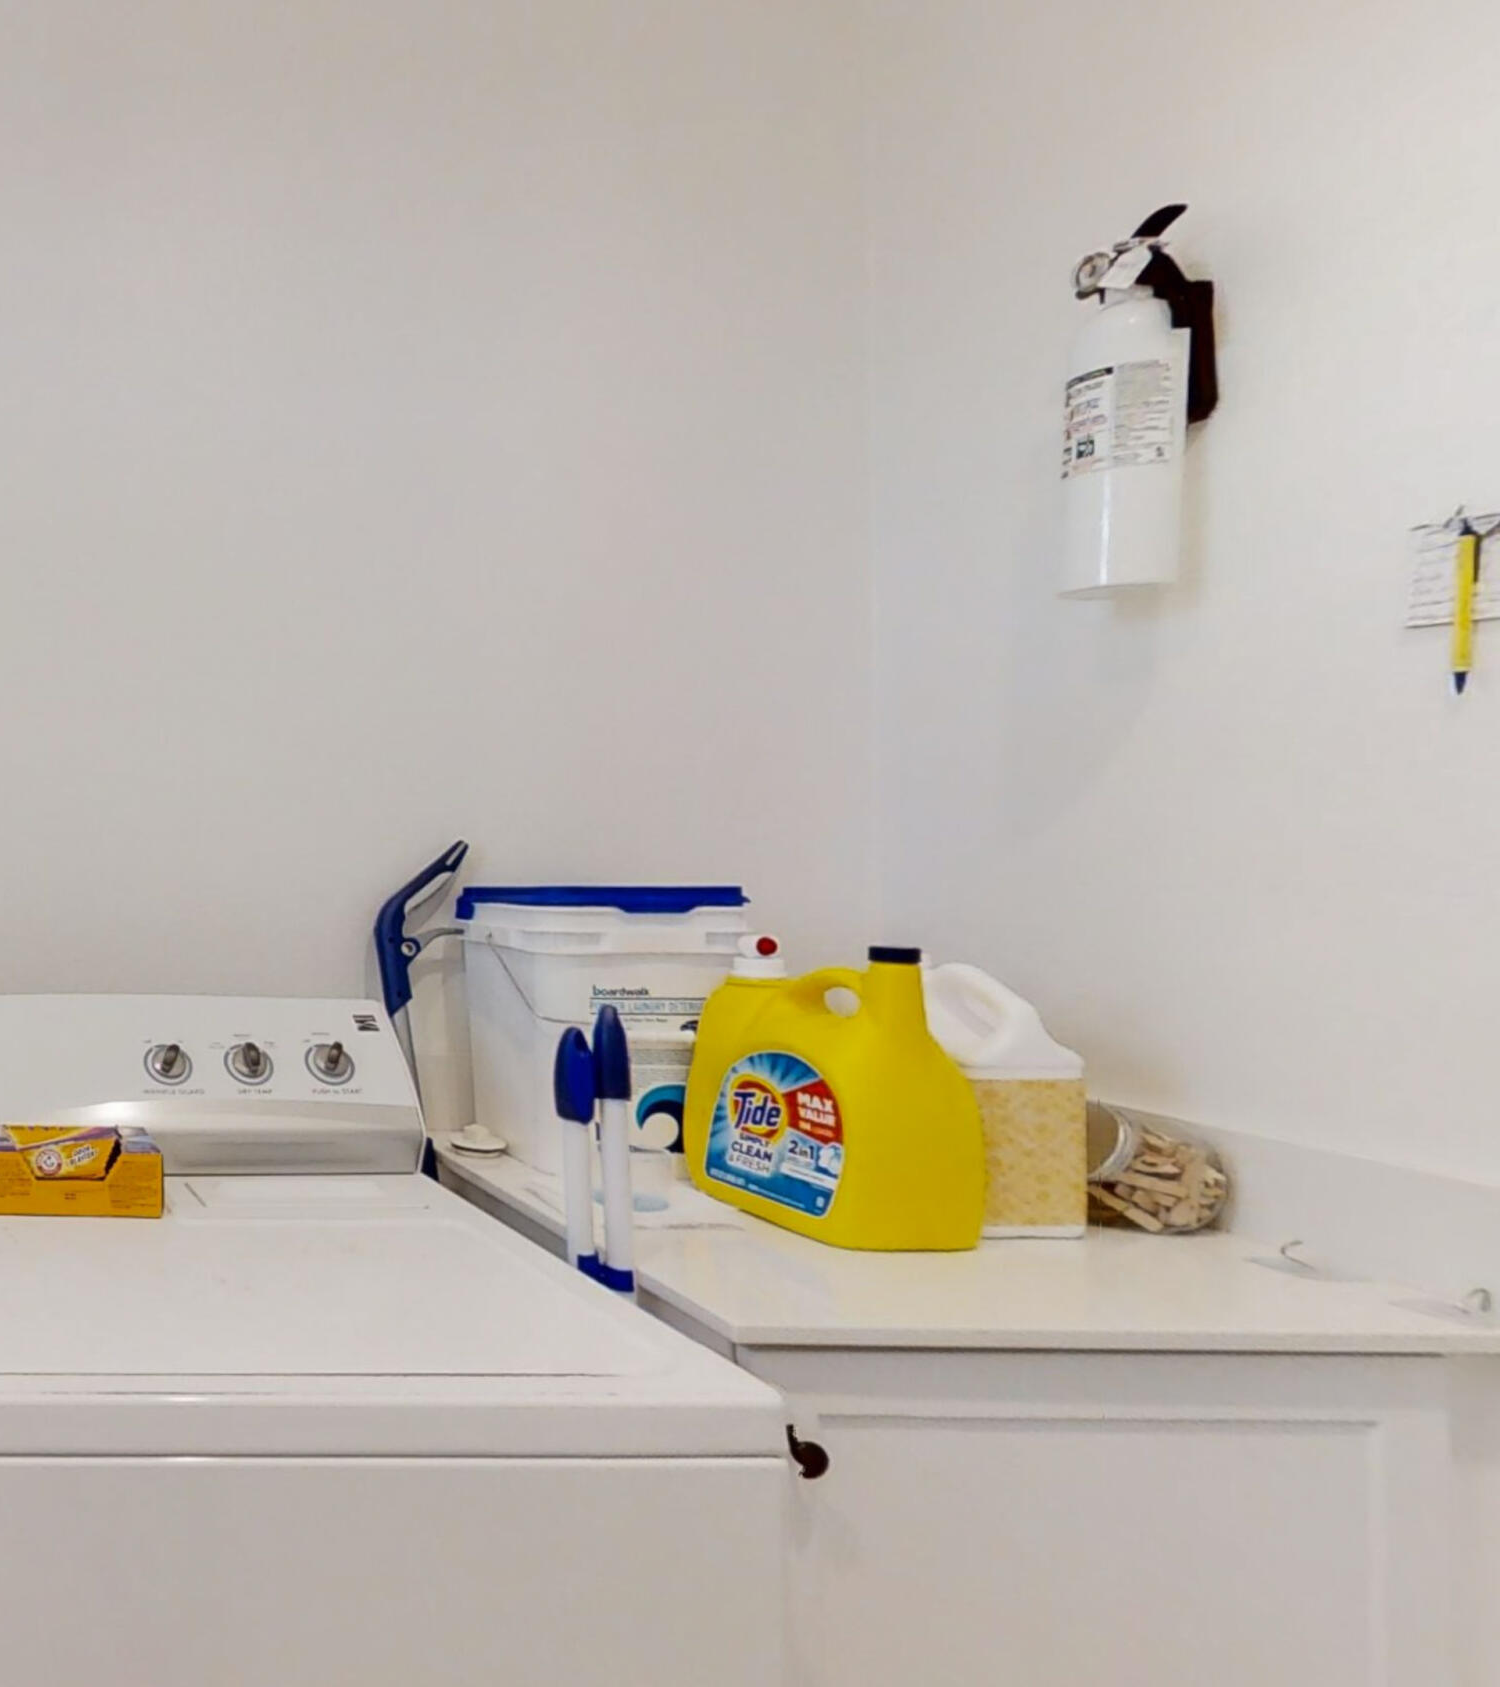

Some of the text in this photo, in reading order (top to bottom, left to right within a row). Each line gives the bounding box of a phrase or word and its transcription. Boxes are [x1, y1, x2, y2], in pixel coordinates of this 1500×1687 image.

[733, 1090, 781, 1129] Tide
[796, 1091, 835, 1114] MAX
[731, 1140, 773, 1163] CLEAN
